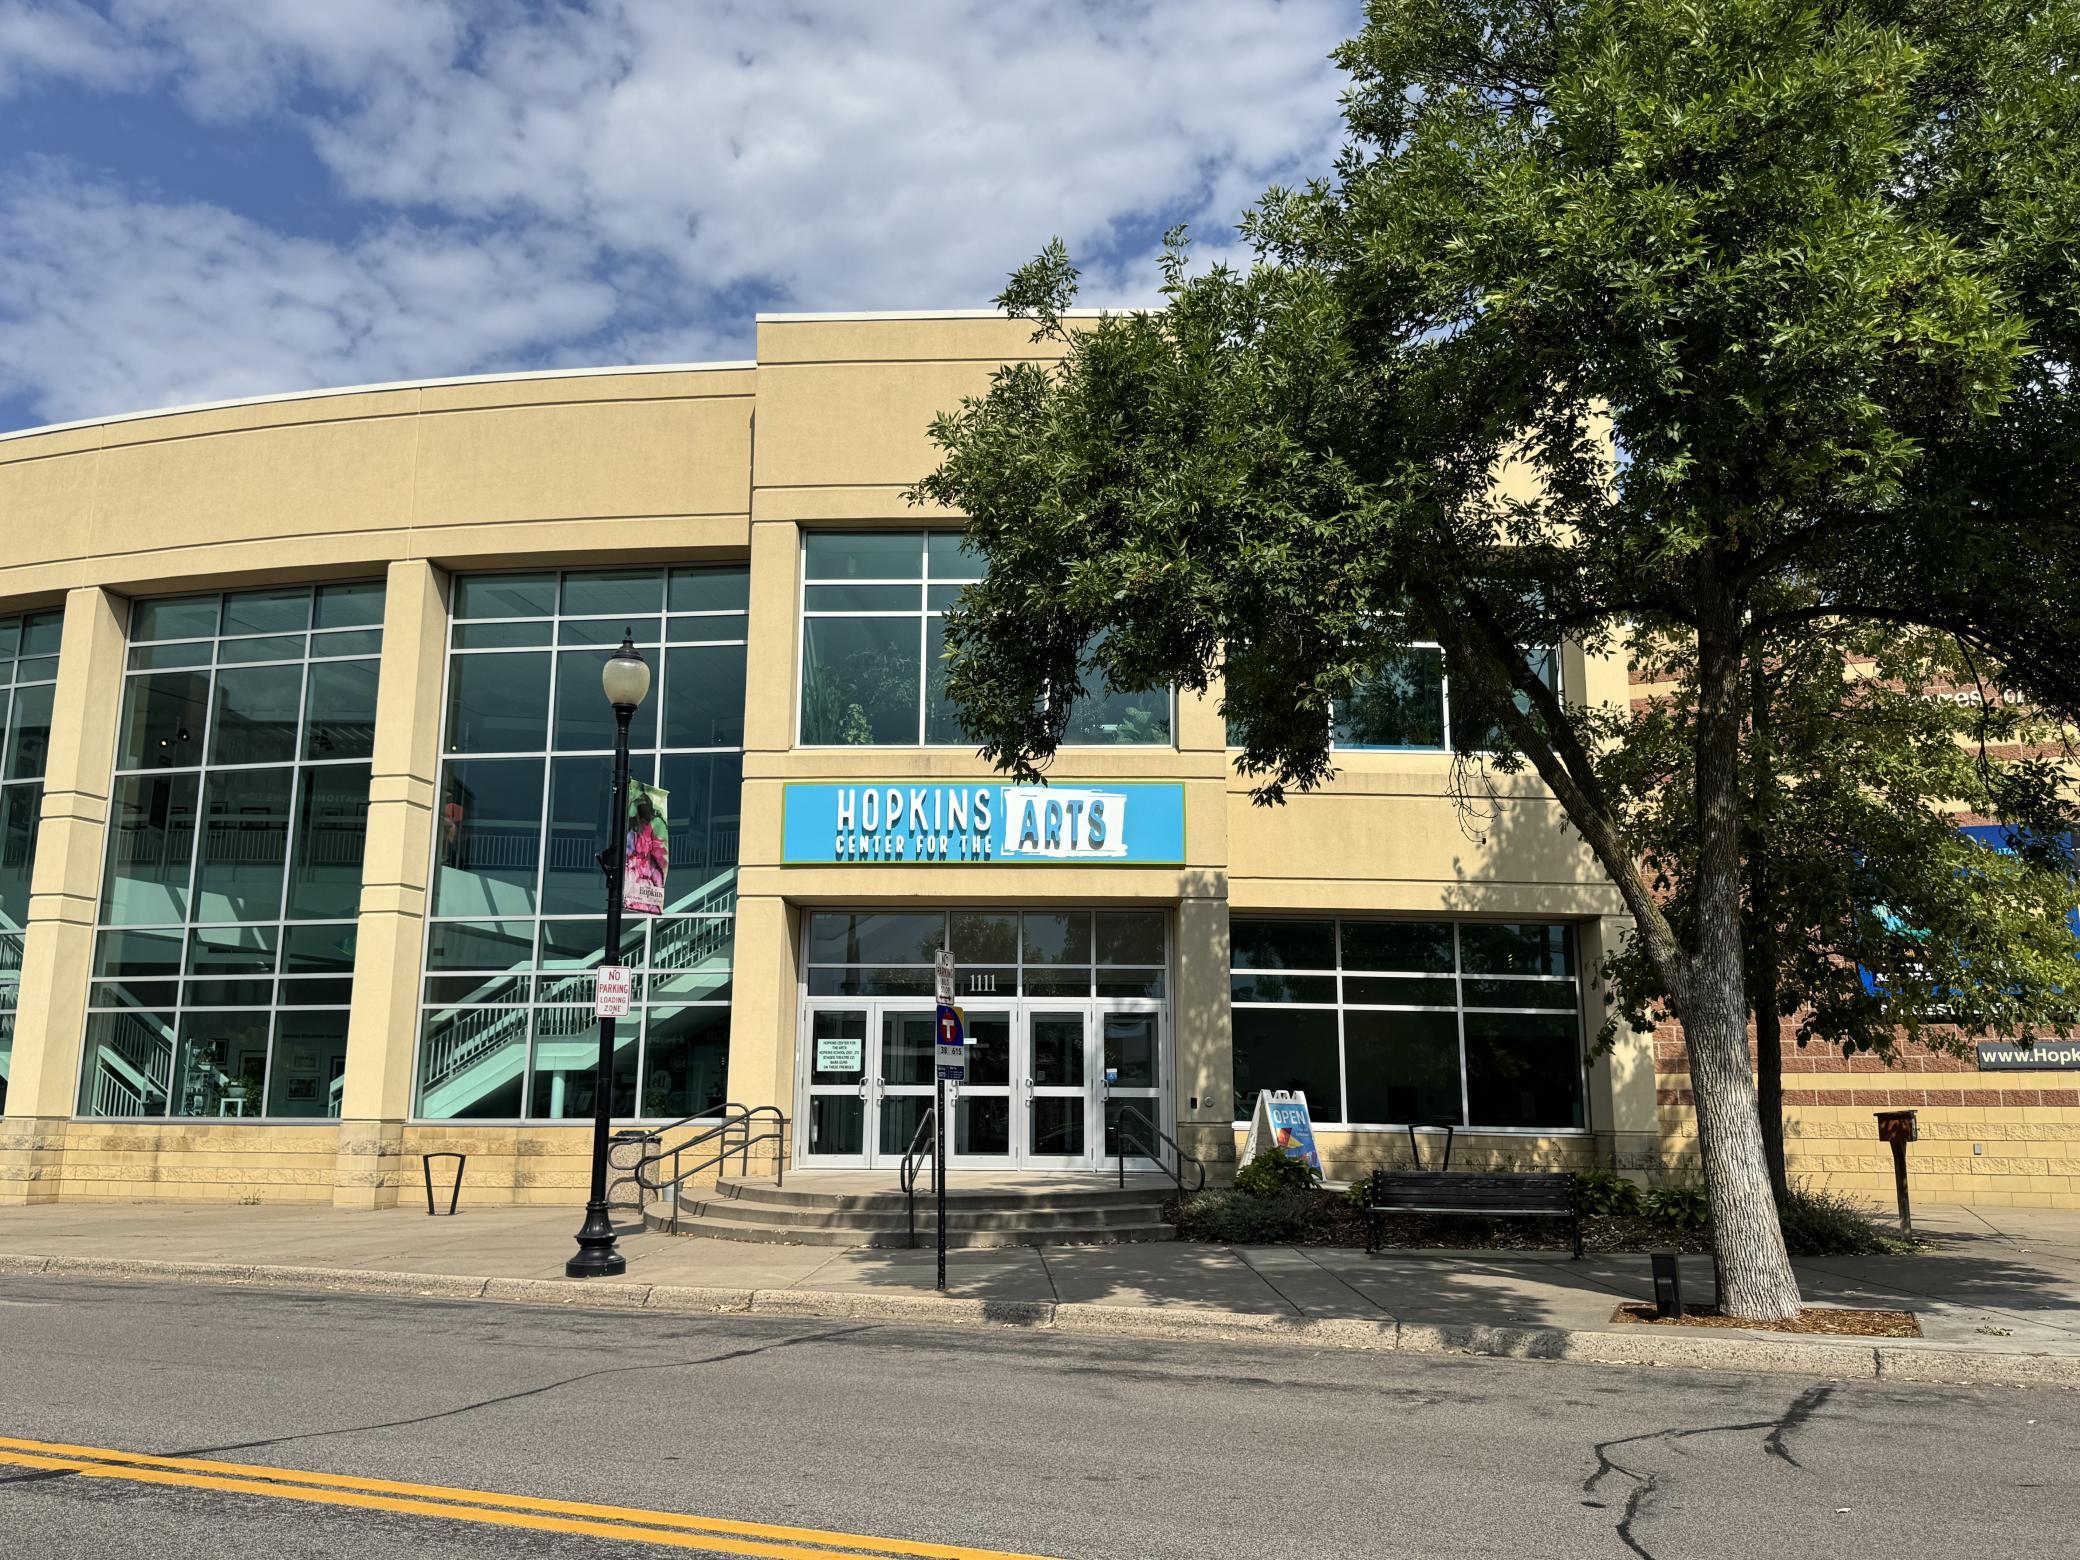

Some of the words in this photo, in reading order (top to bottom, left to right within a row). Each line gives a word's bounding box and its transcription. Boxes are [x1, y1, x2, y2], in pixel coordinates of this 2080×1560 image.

[837, 788, 992, 832] HOPKINS
[1019, 799, 1108, 848] ARTS
[835, 835, 905, 855] CENTER
[916, 835, 948, 855] FOR
[959, 834, 992, 854] THE
[609, 971, 621, 981] NO
[969, 974, 996, 992] 1111
[599, 984, 629, 994] PARKING
[600, 996, 626, 1004] LOADING
[604, 1004, 622, 1012] ZONE
[1273, 1109, 1307, 1125] OPEN
